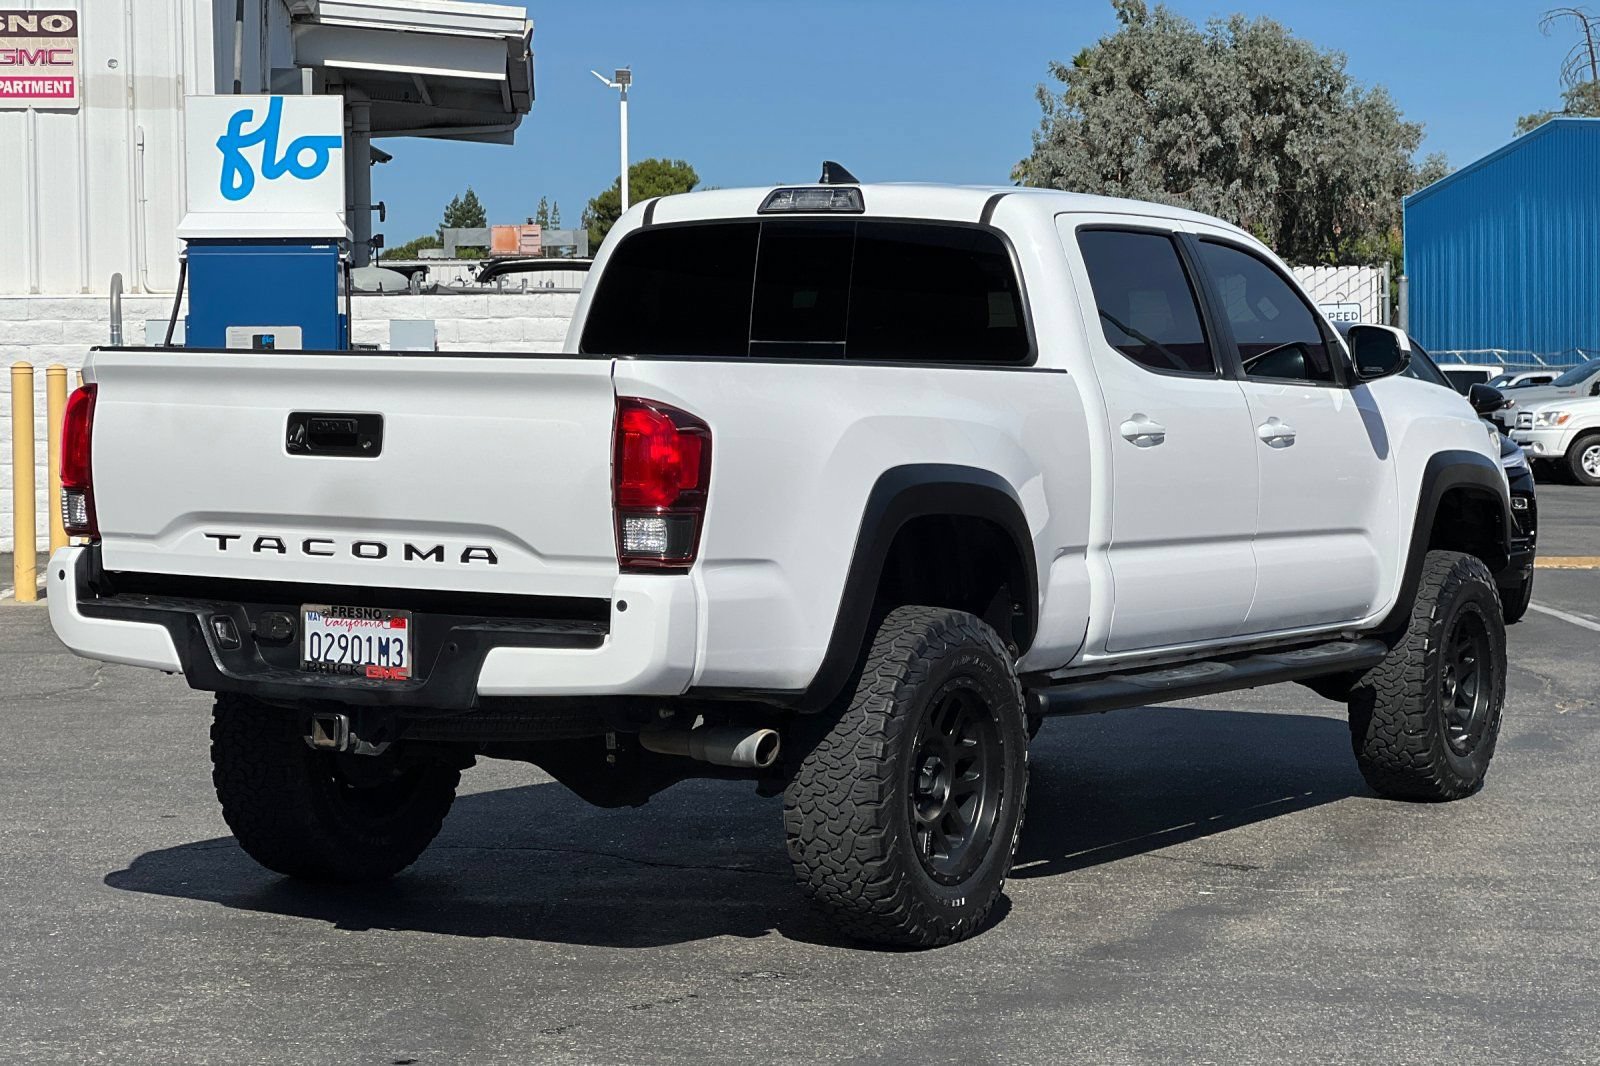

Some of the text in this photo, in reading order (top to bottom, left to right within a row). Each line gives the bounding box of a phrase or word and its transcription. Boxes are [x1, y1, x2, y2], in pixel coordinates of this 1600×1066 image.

[0, 14, 74, 33] NO
[0, 48, 74, 66] GMC
[216, 96, 342, 201] flo
[1325, 312, 1359, 321] PEED
[203, 532, 499, 565] TACOMA
[307, 612, 321, 621] MAY
[331, 606, 382, 619] FRESNO
[324, 617, 384, 632] California
[309, 632, 404, 668] 02901M3
[365, 665, 407, 681] GMC
